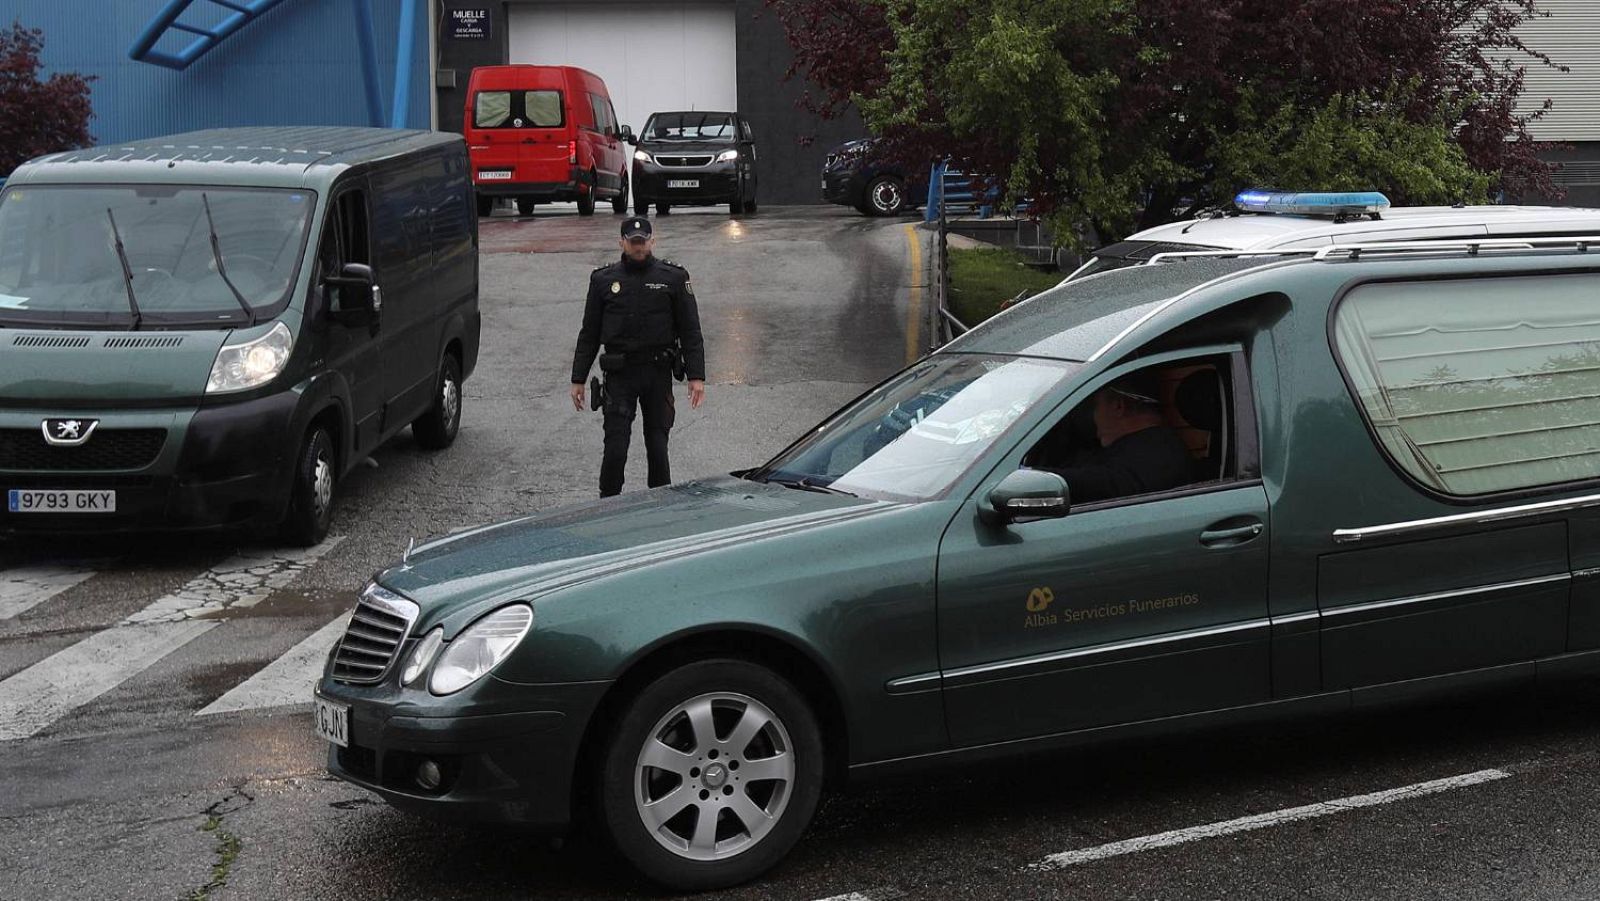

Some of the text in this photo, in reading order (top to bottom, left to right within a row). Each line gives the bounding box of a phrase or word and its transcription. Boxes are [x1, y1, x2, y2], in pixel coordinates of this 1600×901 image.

[453, 10, 485, 18] MUELLE
[22, 493, 111, 508] 9793 GKY
[1024, 592, 1199, 628] Albia Servicios Funerarios
[320, 704, 344, 740] GJN
